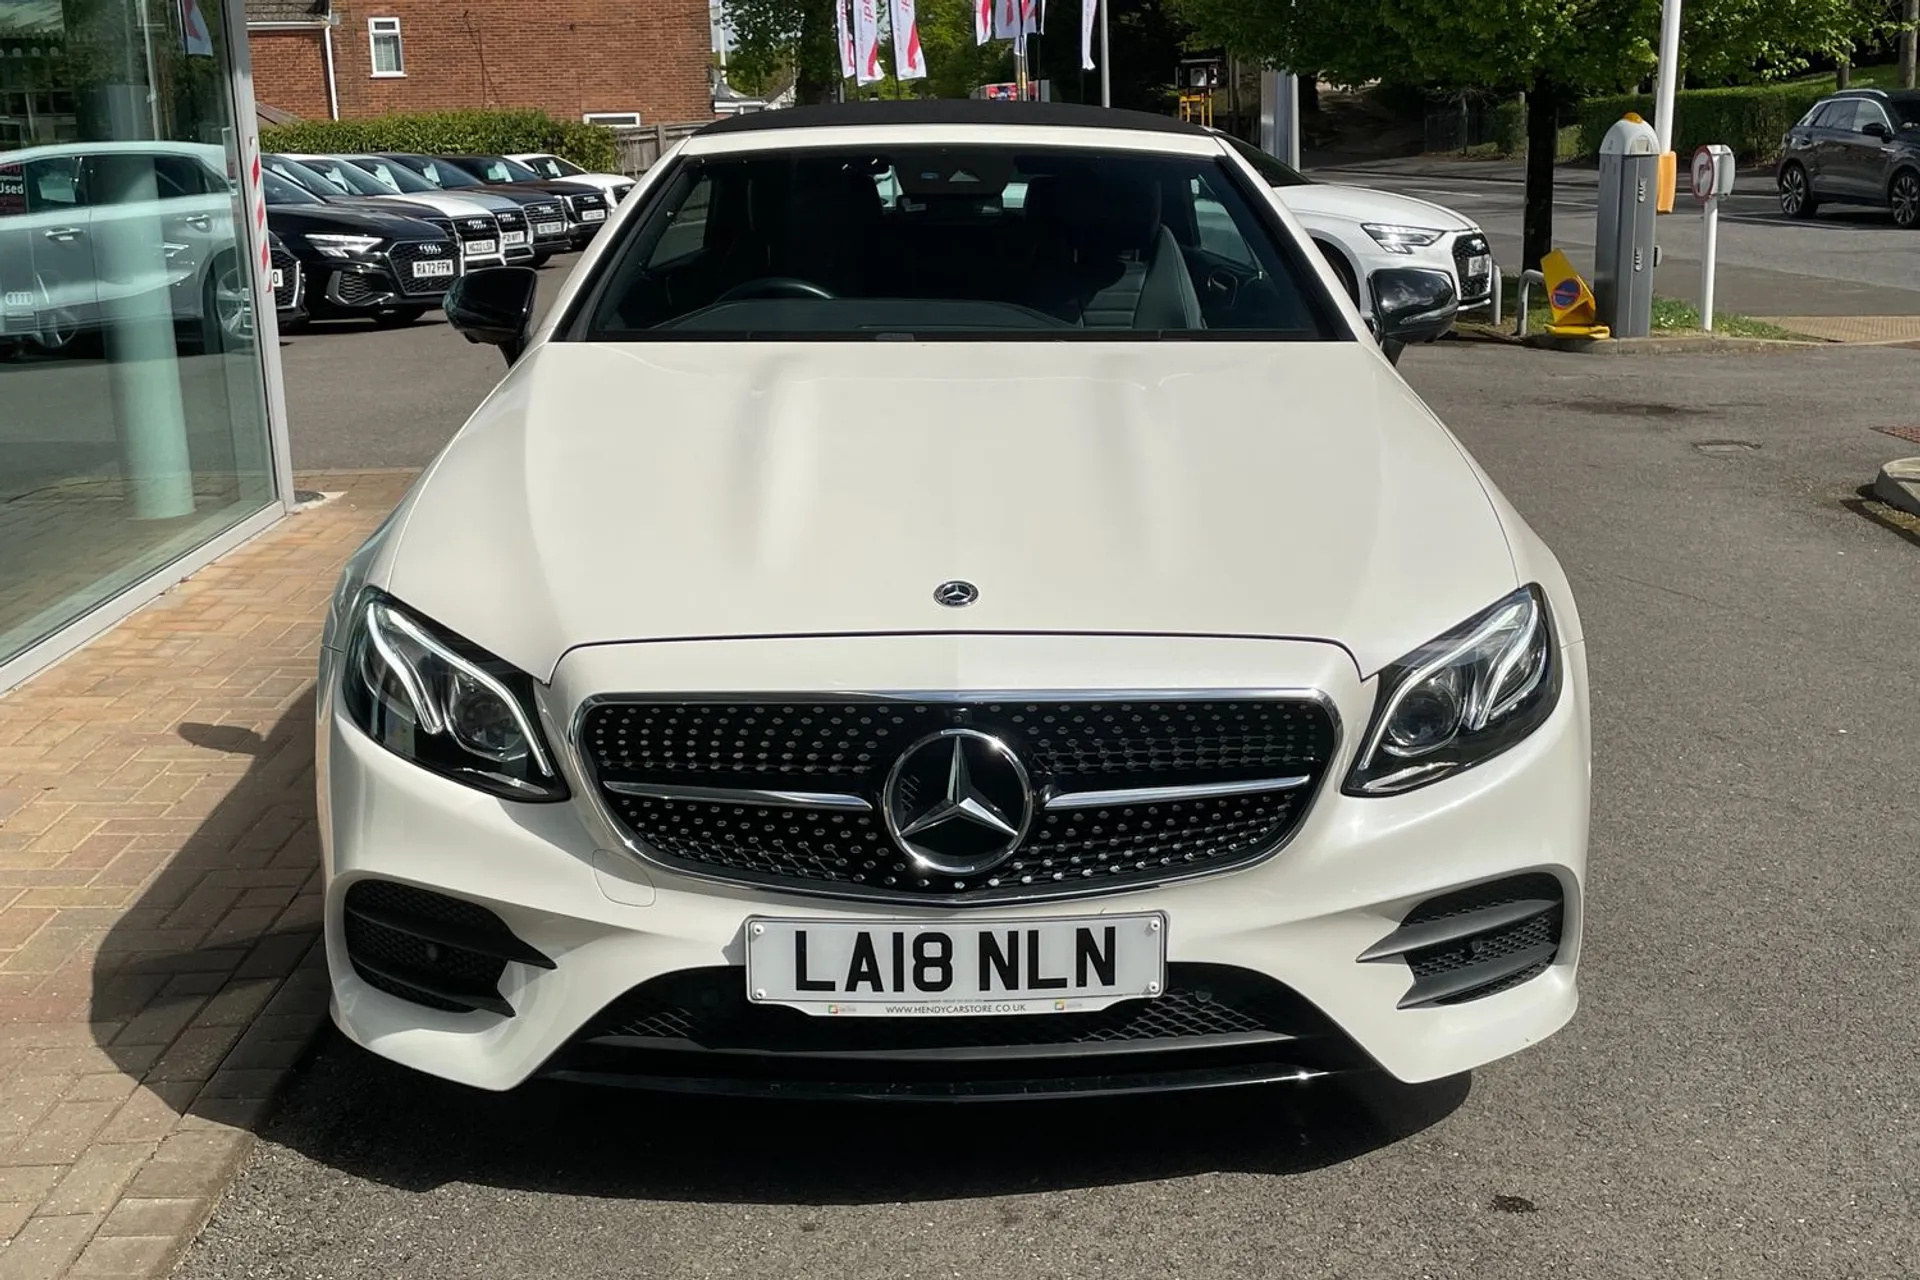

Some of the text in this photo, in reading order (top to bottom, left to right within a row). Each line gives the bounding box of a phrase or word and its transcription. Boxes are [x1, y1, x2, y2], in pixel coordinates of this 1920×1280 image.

[416, 263, 436, 275] RA72
[795, 926, 1116, 992] LA18 NLN
[885, 1003, 1026, 1015] WWW.HENDYCARSTORE.CO.UK
